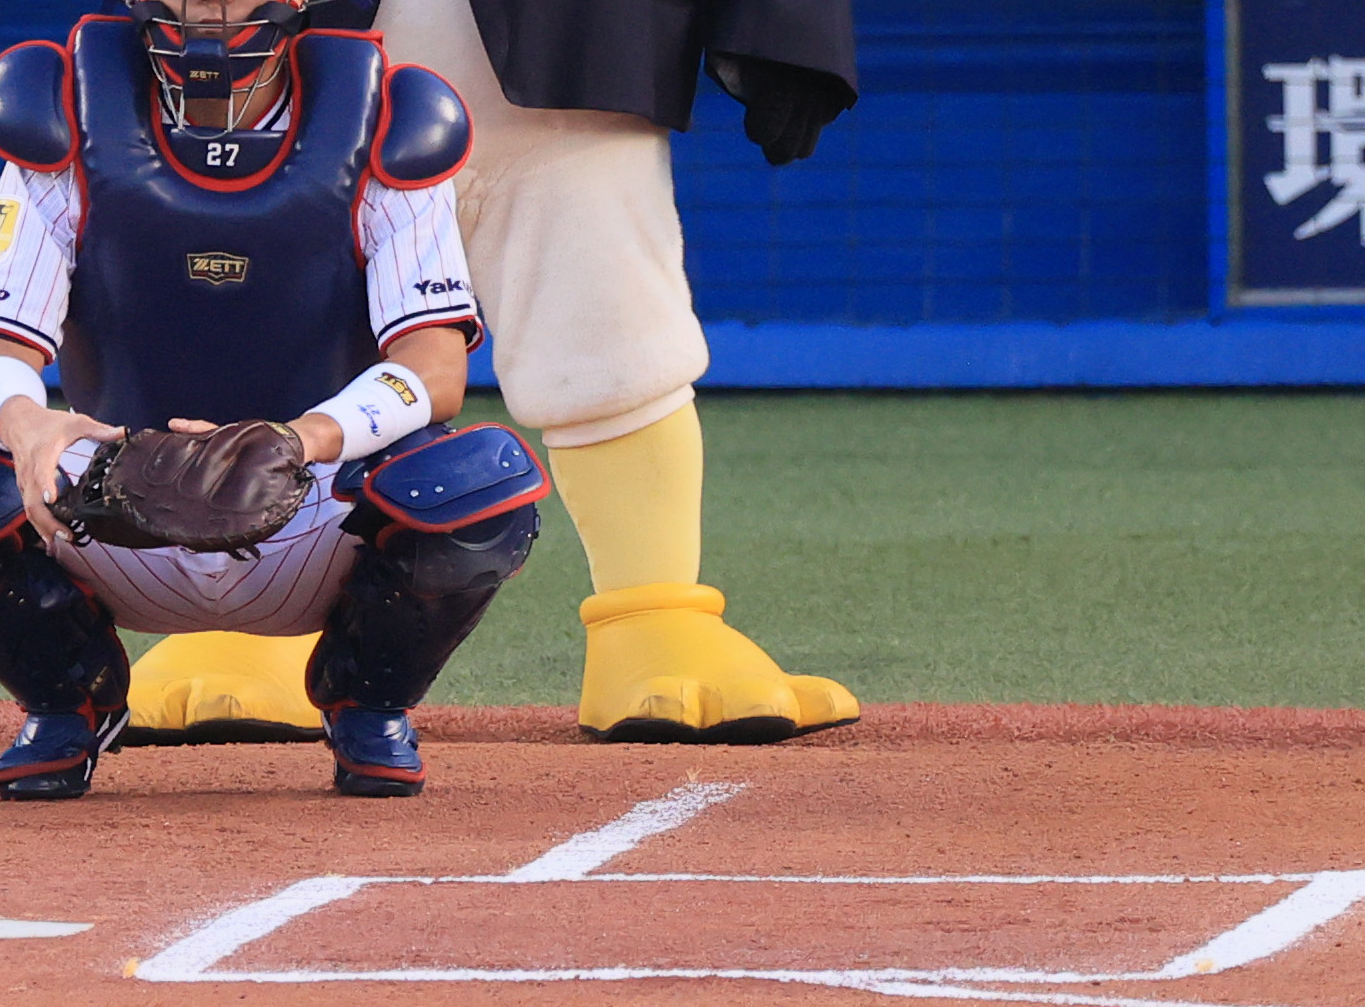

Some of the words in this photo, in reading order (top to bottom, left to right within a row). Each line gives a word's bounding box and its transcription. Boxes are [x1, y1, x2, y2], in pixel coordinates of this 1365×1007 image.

[206, 142, 240, 167] 27
[193, 258, 245, 274] ZETT
[412, 277, 474, 299] Yak
